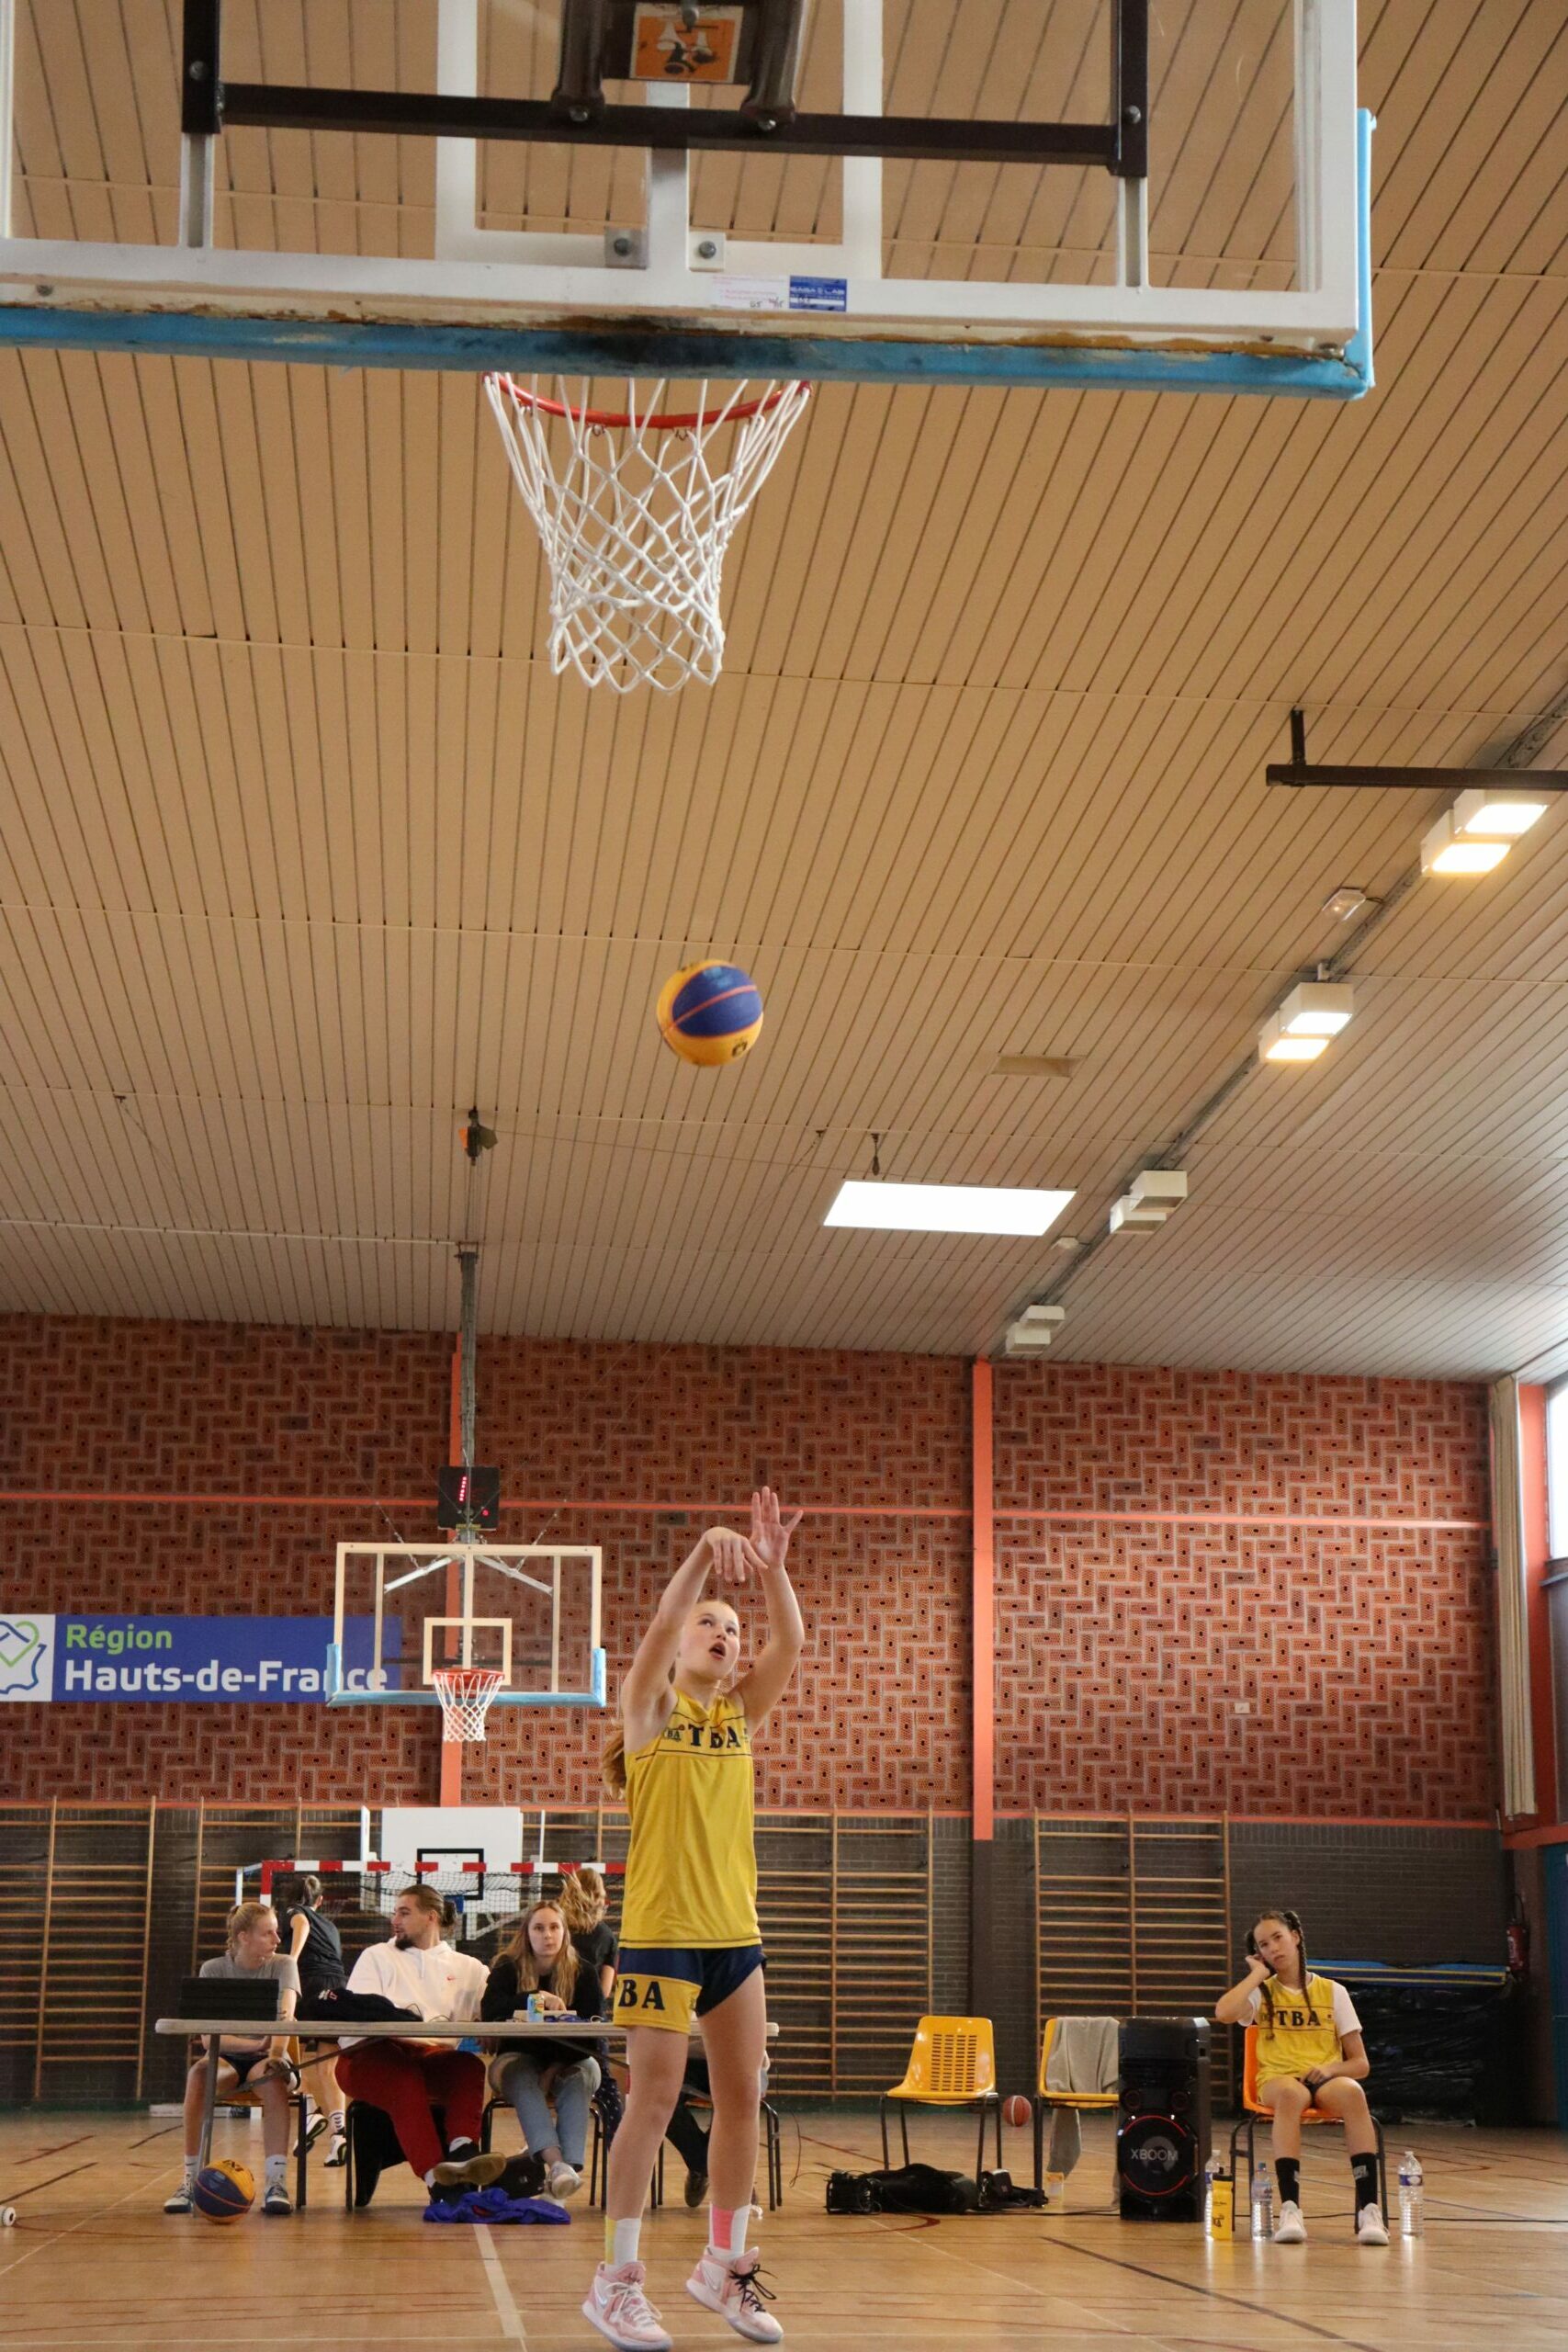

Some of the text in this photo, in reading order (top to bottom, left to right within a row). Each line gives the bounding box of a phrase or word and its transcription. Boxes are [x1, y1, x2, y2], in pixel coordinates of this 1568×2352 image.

[66, 1623, 173, 1655] Région
[688, 1724, 740, 1748] TBA
[616, 1979, 665, 2010] BA
[1276, 2010, 1321, 2026] TBA
[1131, 2148, 1179, 2161] XBOOM
